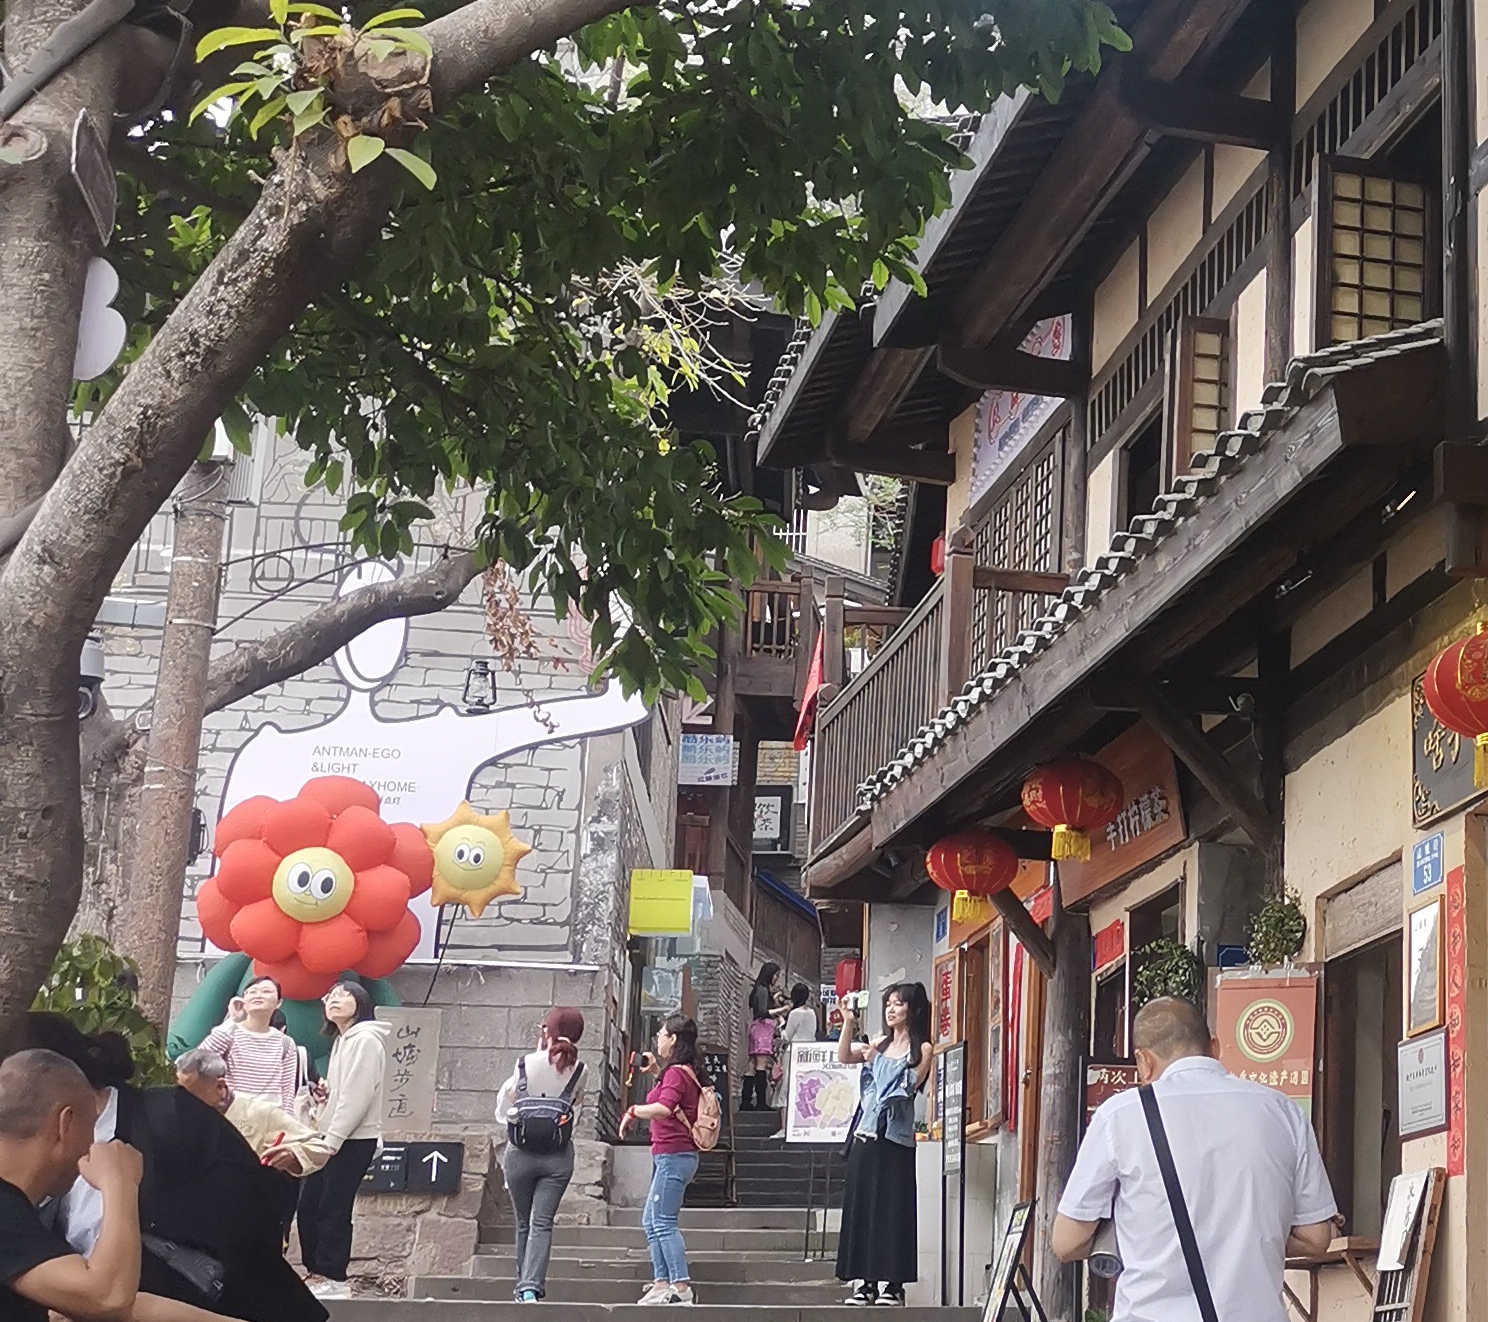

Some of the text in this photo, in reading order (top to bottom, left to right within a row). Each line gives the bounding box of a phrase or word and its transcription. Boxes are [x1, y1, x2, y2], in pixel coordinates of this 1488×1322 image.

[312, 745, 401, 759] ANTMAN-EGO
[311, 762, 358, 773] &LIGHT
[362, 780, 416, 792] YHOME
[380, 796, 401, 805] 点灯
[388, 1025, 421, 1119] 山城步道
